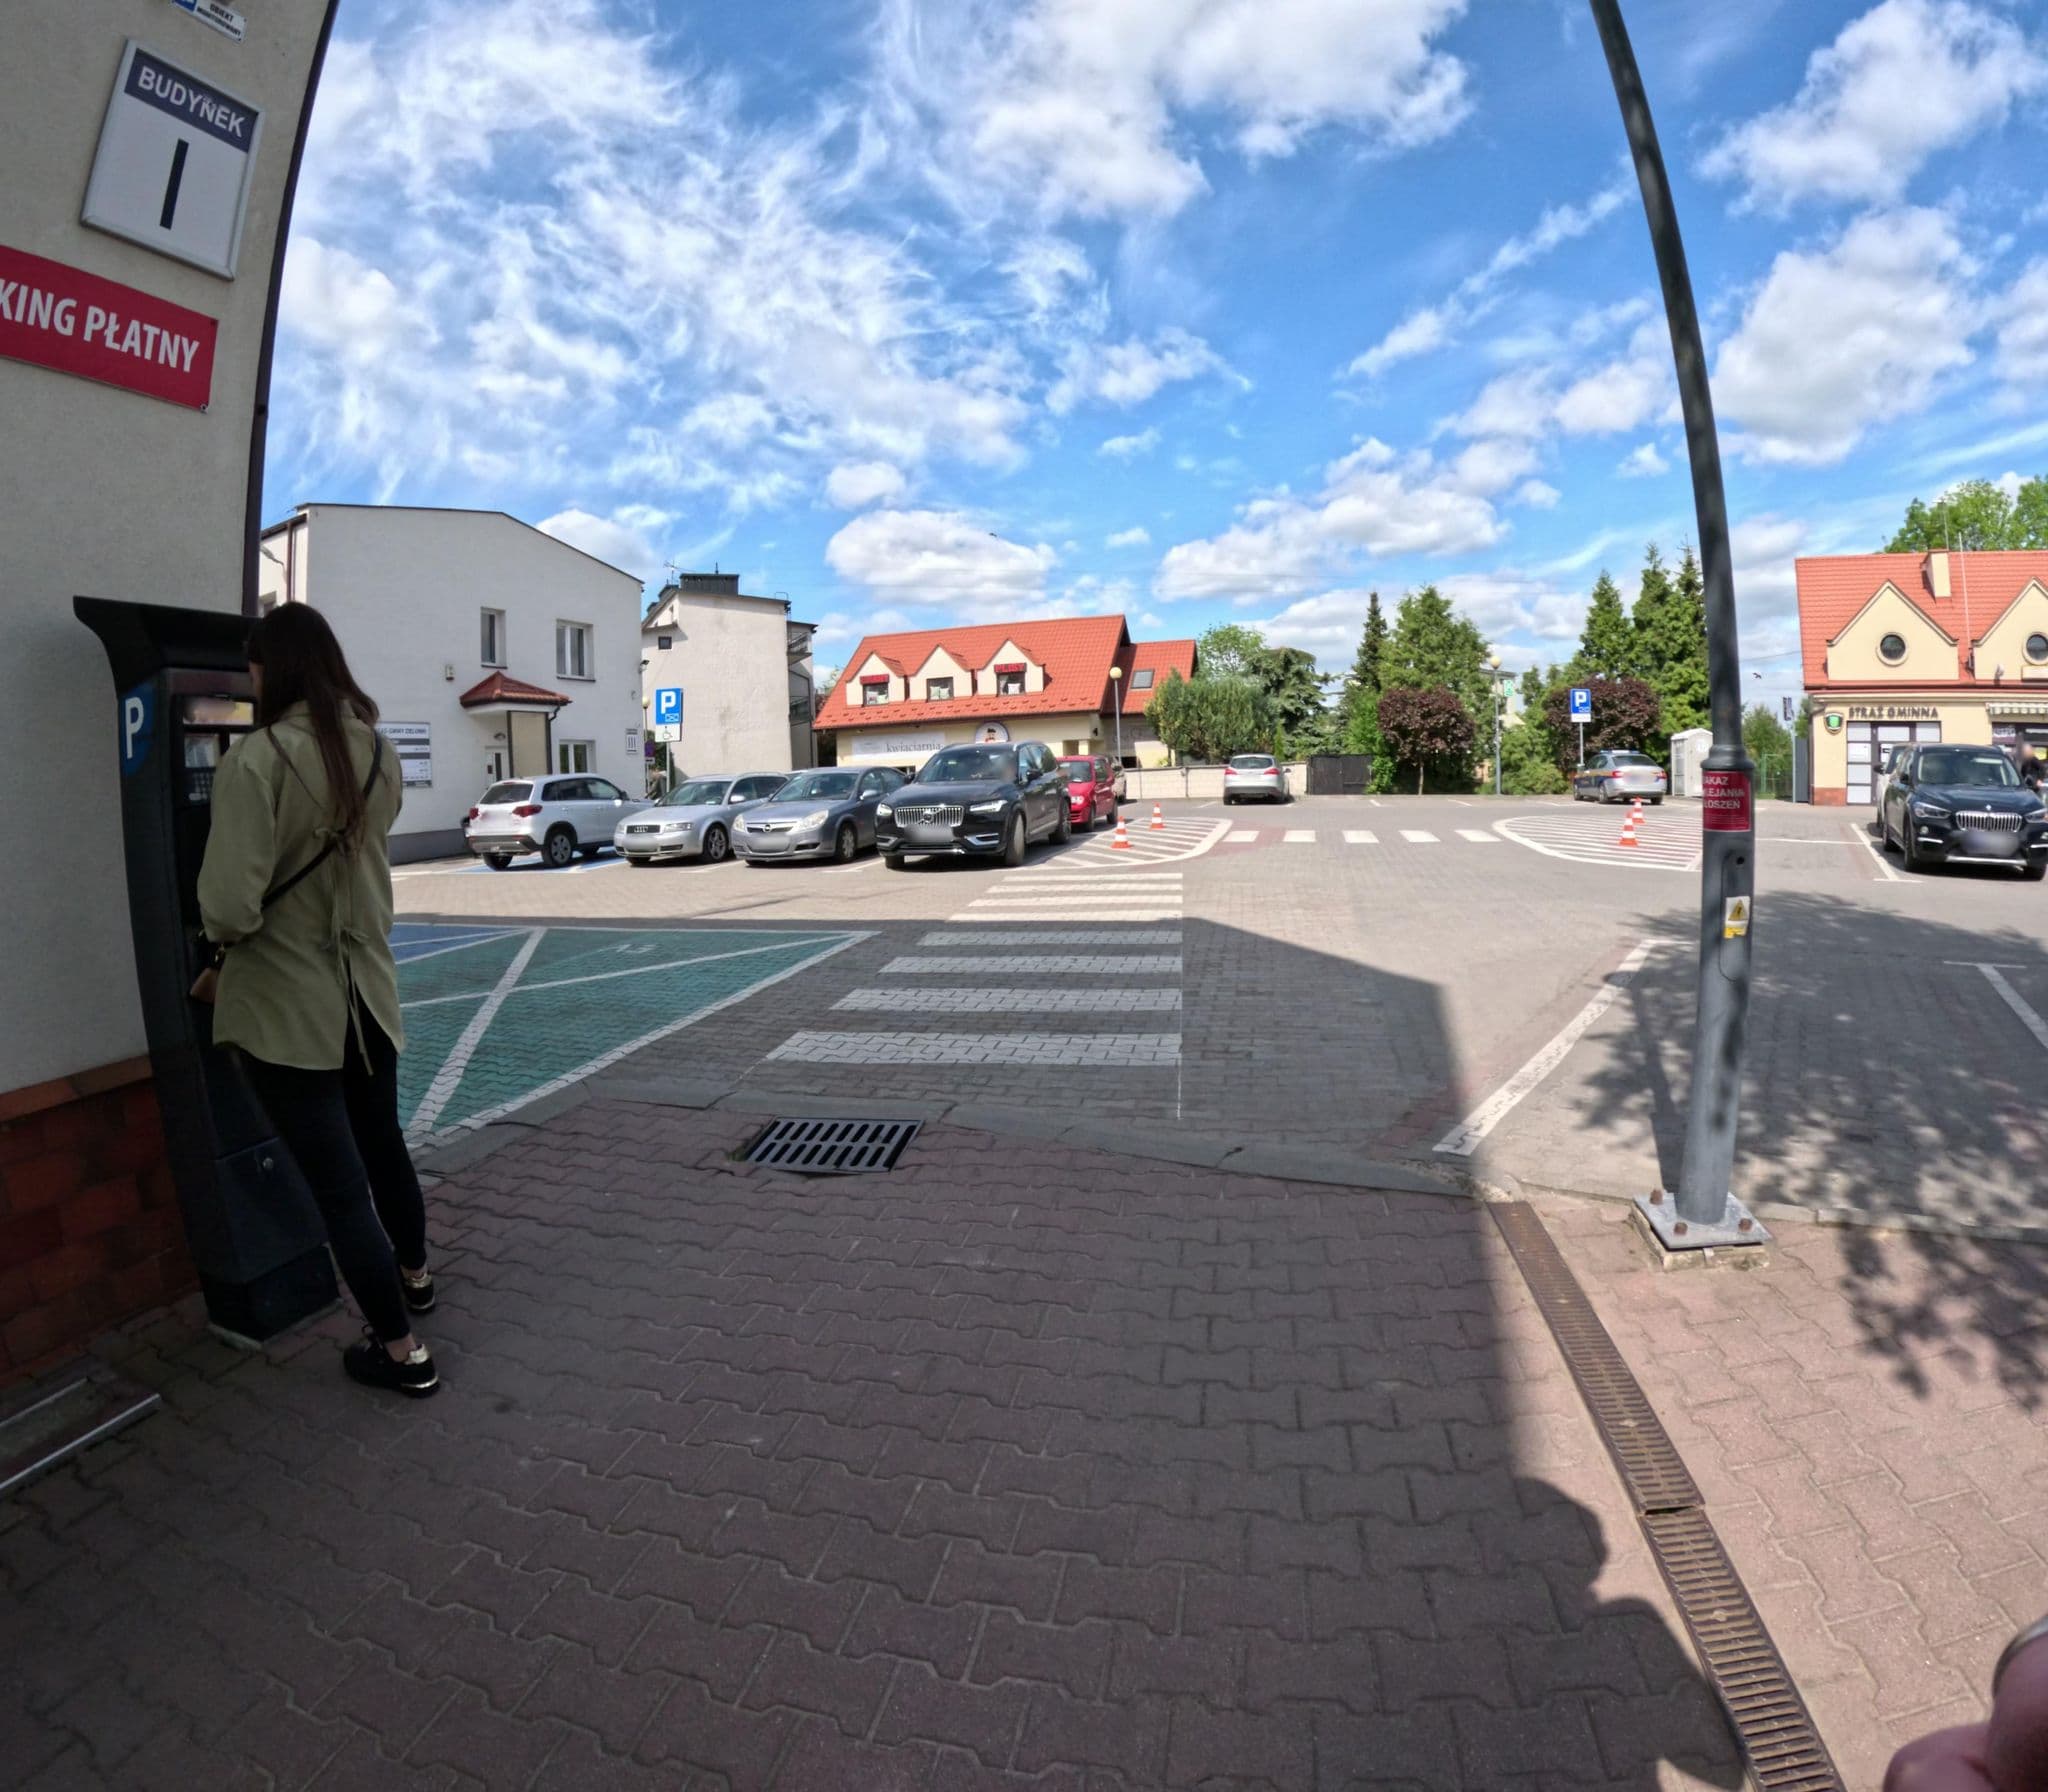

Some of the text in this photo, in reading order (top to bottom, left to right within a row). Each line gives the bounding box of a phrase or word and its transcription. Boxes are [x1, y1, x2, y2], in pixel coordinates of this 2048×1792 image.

[83, 305, 200, 373] PŁATNY
[661, 691, 677, 715] P
[1575, 692, 1587, 707] P
[1887, 707, 1939, 718] GMINNA
[125, 697, 145, 759] P
[886, 739, 941, 753] kwiaciarnia
